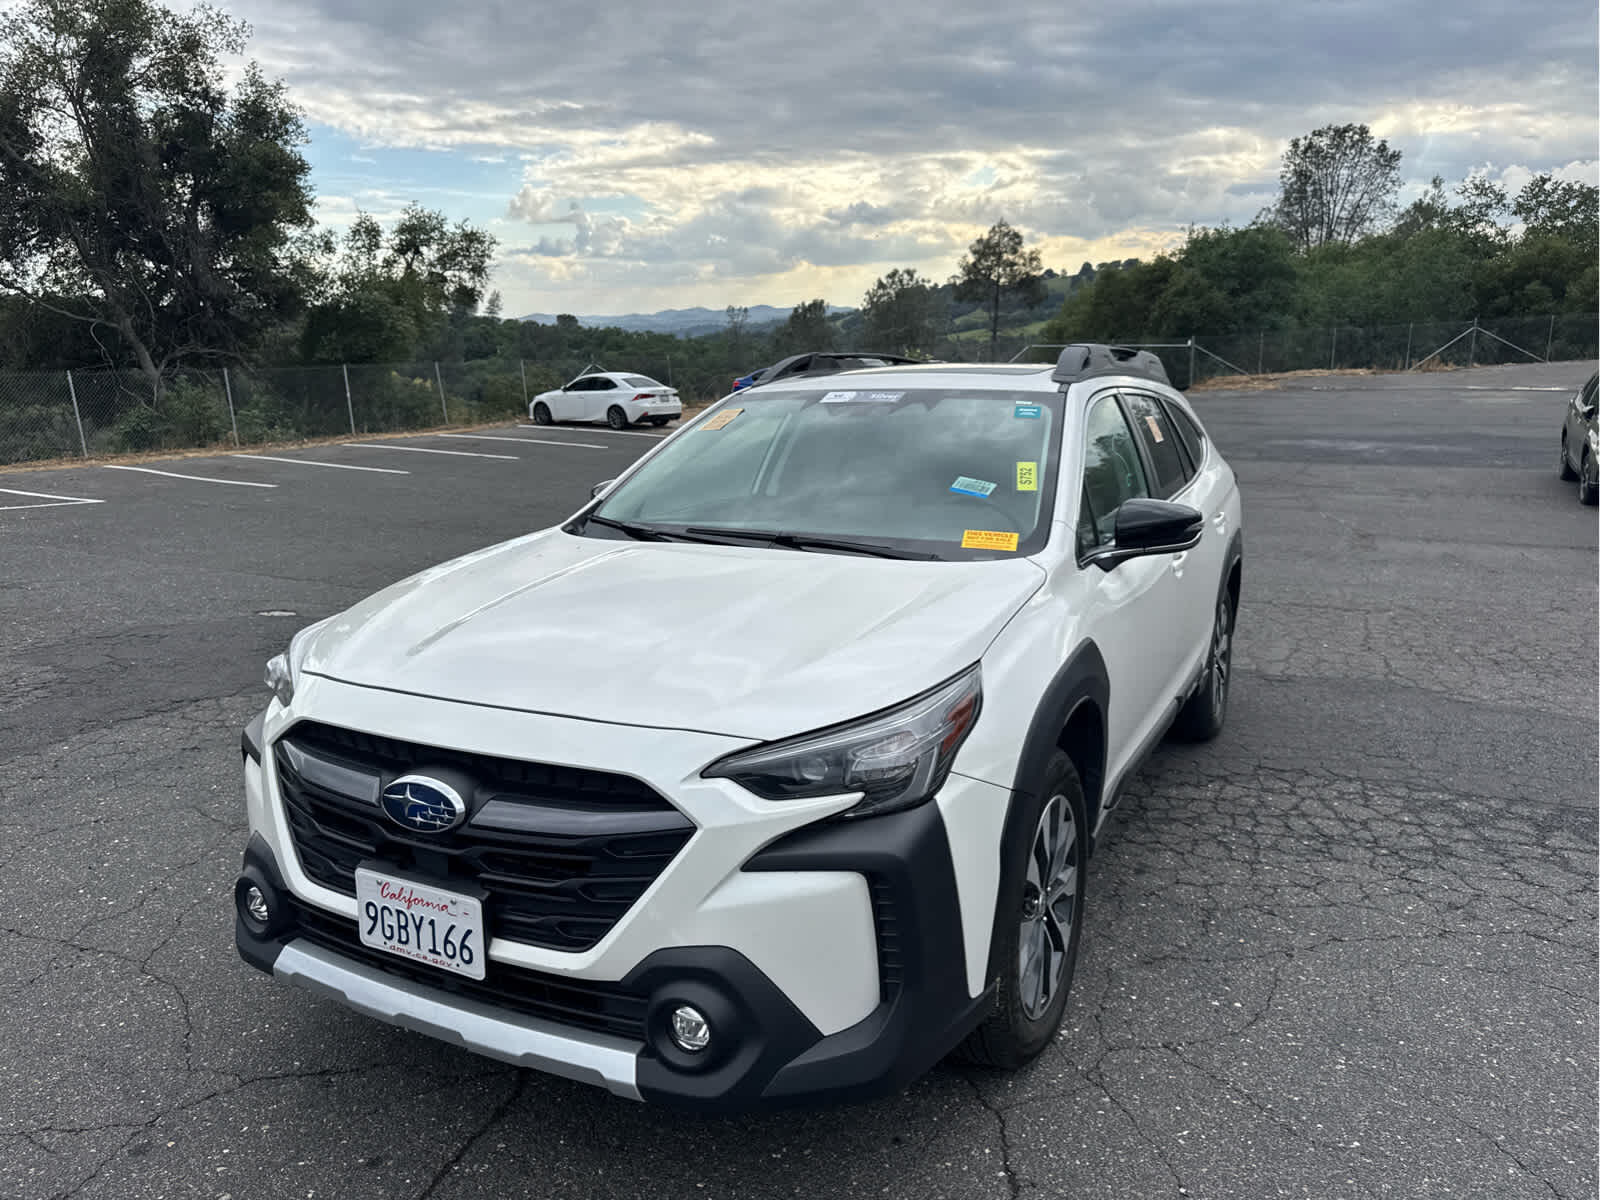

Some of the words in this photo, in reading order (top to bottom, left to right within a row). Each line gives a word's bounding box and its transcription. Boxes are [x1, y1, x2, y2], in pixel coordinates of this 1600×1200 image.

[380, 881, 456, 916] California
[365, 901, 473, 965] 9GBY166
[389, 944, 452, 967] dmv.ca.gov
